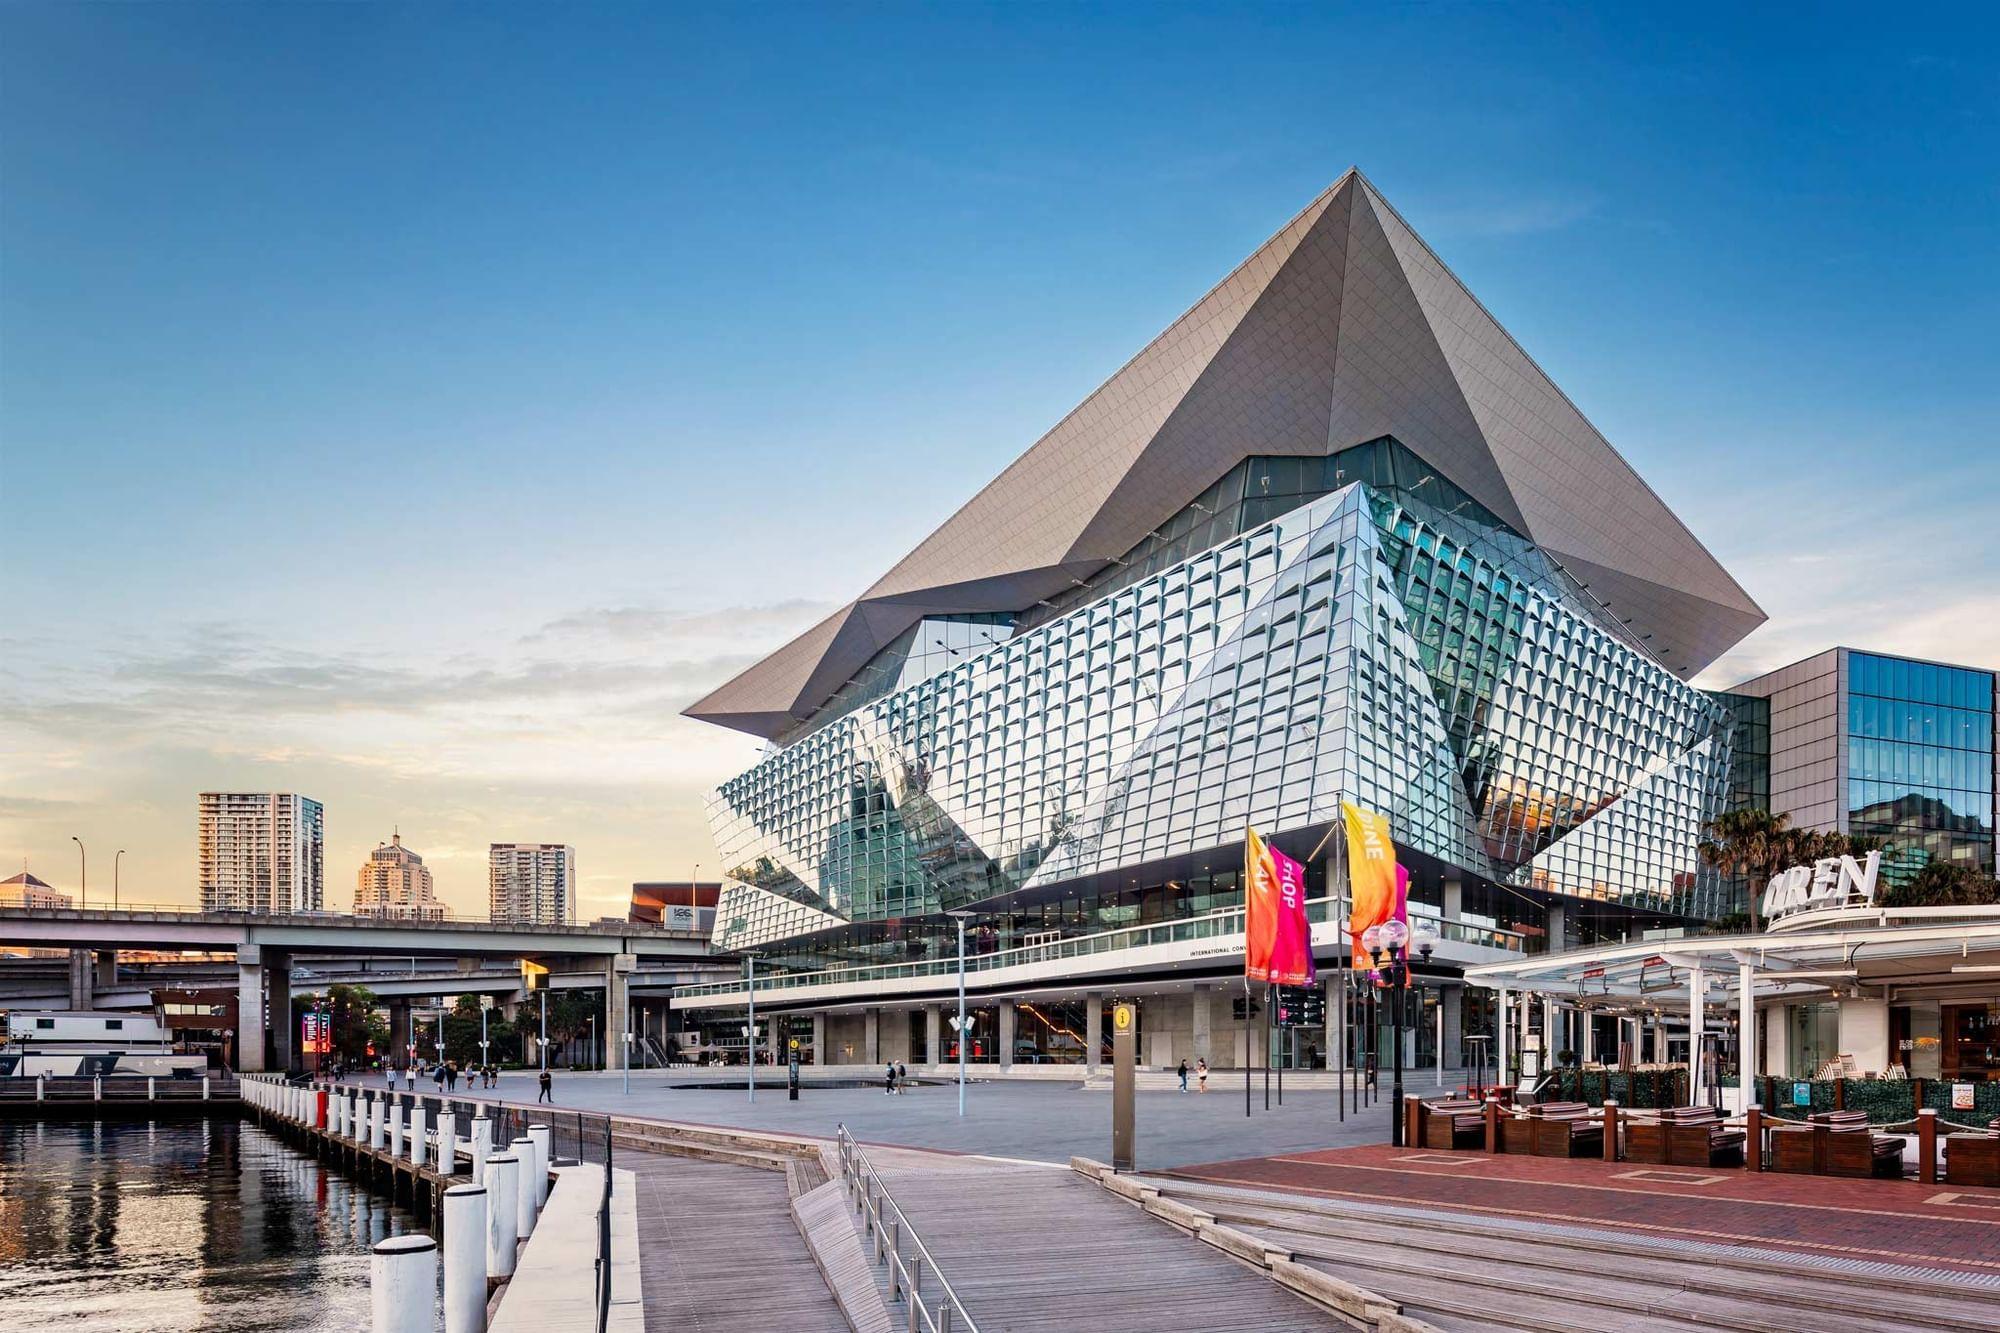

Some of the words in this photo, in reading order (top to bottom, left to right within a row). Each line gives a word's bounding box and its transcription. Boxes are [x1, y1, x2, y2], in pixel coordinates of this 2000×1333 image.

[1358, 813, 1385, 860] DINE
[1282, 859, 1296, 908] SHOP
[1190, 947, 1229, 956] INTERNATIONAL
